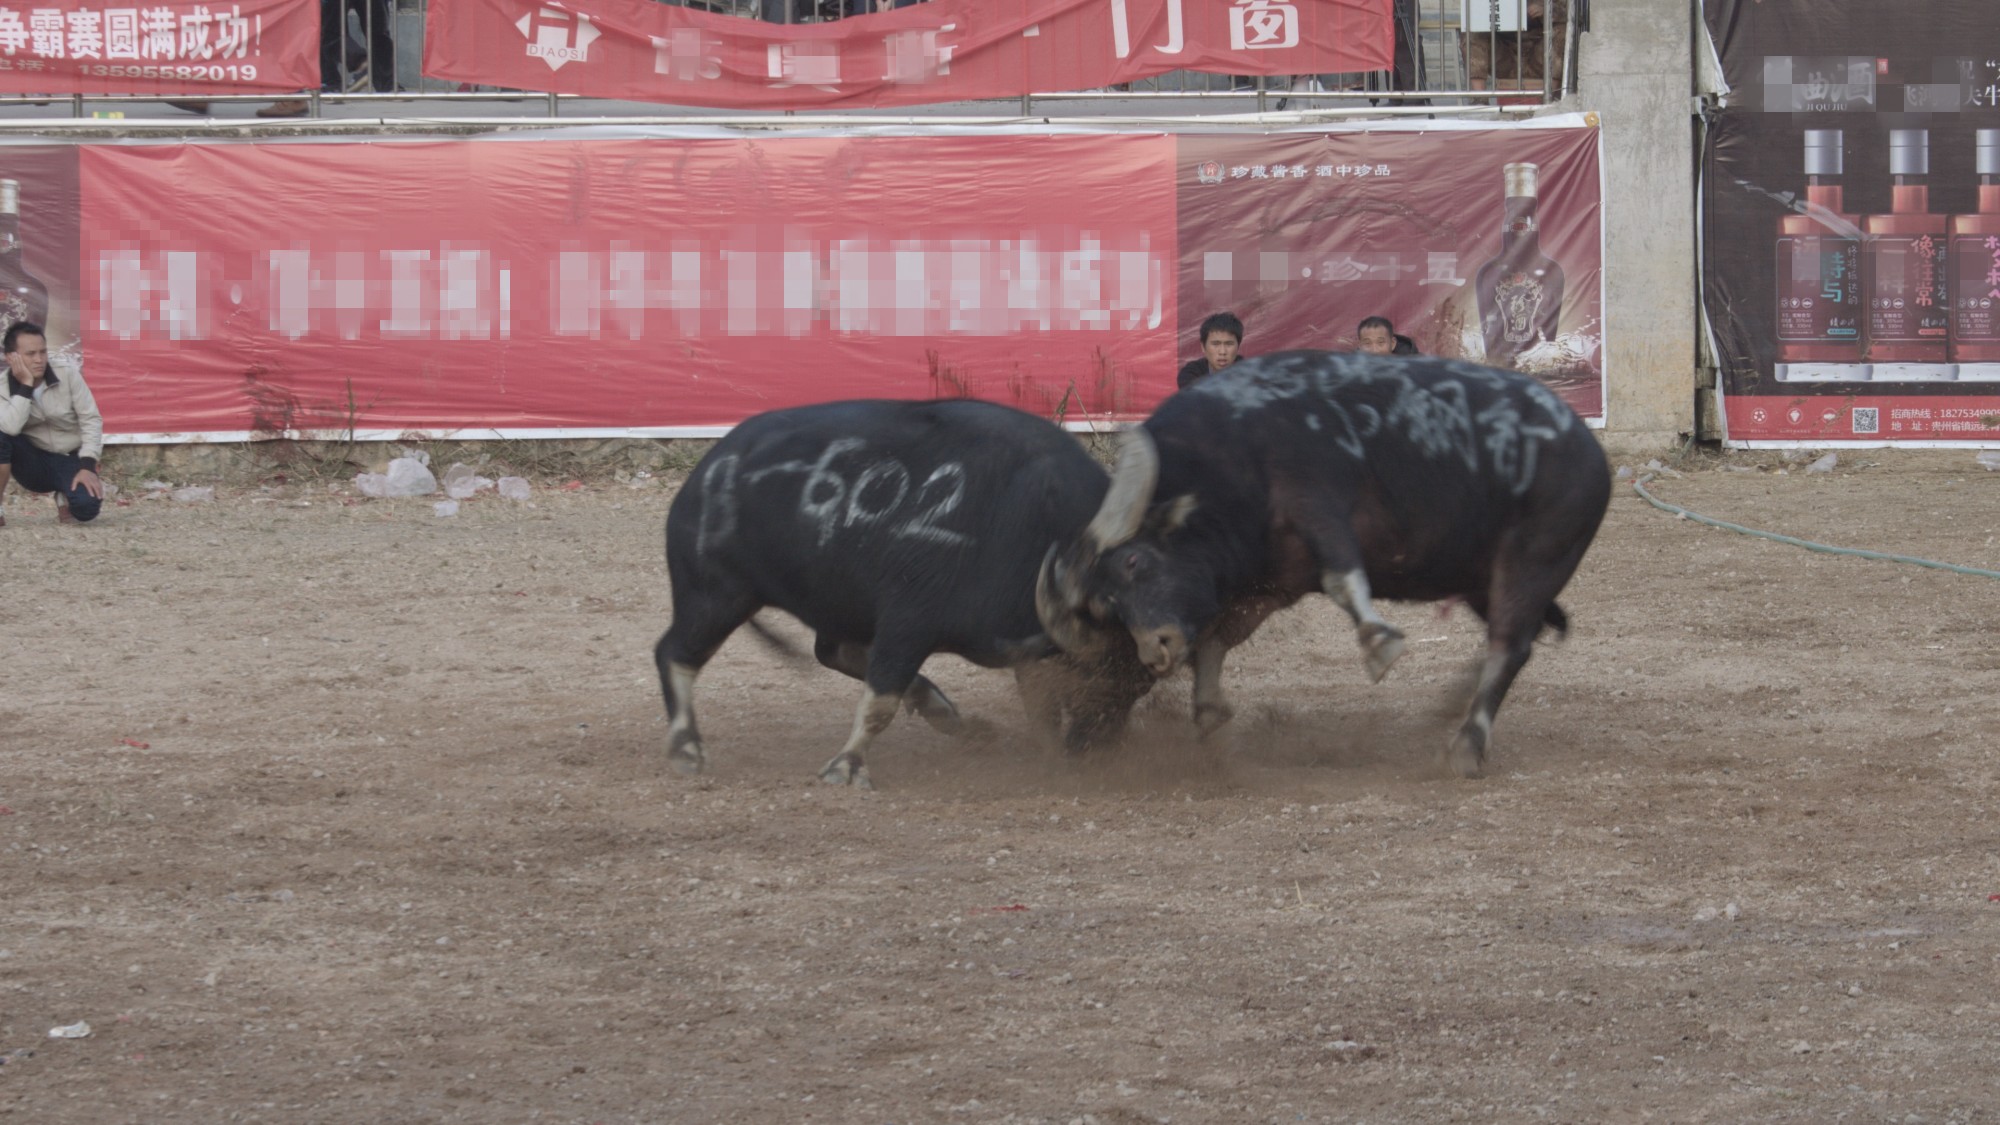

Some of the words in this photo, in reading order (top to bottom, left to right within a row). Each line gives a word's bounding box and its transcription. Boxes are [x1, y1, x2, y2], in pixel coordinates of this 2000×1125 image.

[529, 45, 585, 60] DIAOSI
[79, 64, 257, 81] 13595582019
[1231, 164, 1308, 179] 珍藏酱香
[1315, 164, 1391, 178] 酒中珍品
